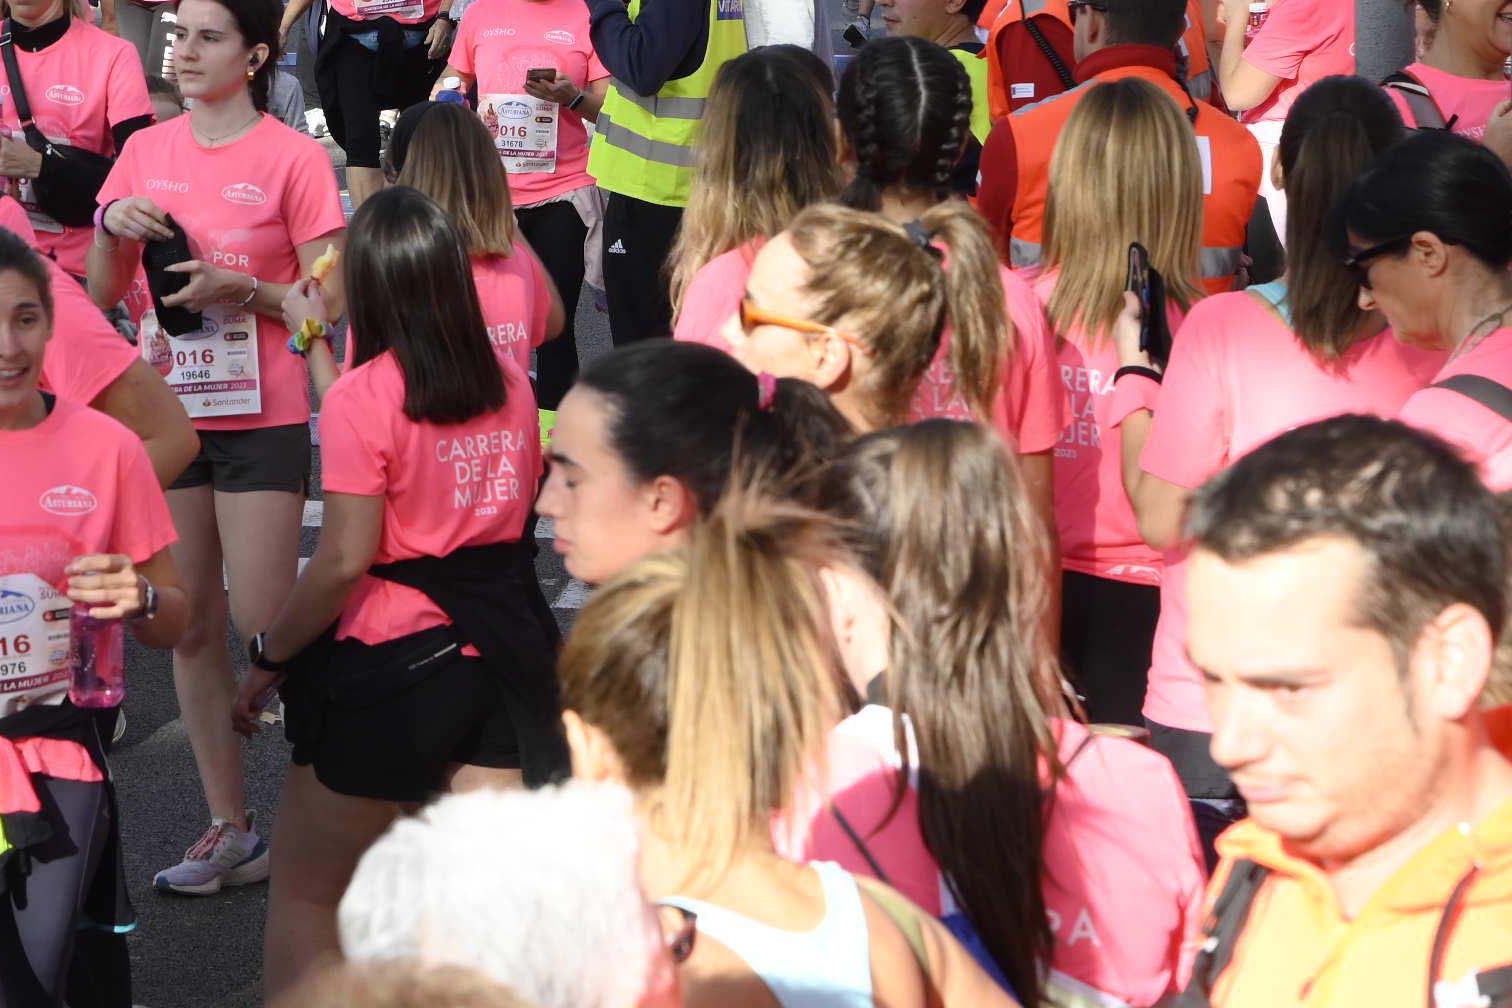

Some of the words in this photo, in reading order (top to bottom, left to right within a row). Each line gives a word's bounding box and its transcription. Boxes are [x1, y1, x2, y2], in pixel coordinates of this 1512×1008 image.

[500, 126, 527, 137] 016
[146, 179, 189, 192] OYSHO
[213, 252, 249, 267] POR
[176, 349, 214, 365] 016
[182, 370, 210, 381] 19646
[212, 398, 251, 406] Santander
[437, 429, 526, 463] CARRERA
[455, 460, 481, 484] DE
[487, 455, 516, 478] LA
[454, 478, 520, 509] MUJER
[4, 680, 16, 690] LA
